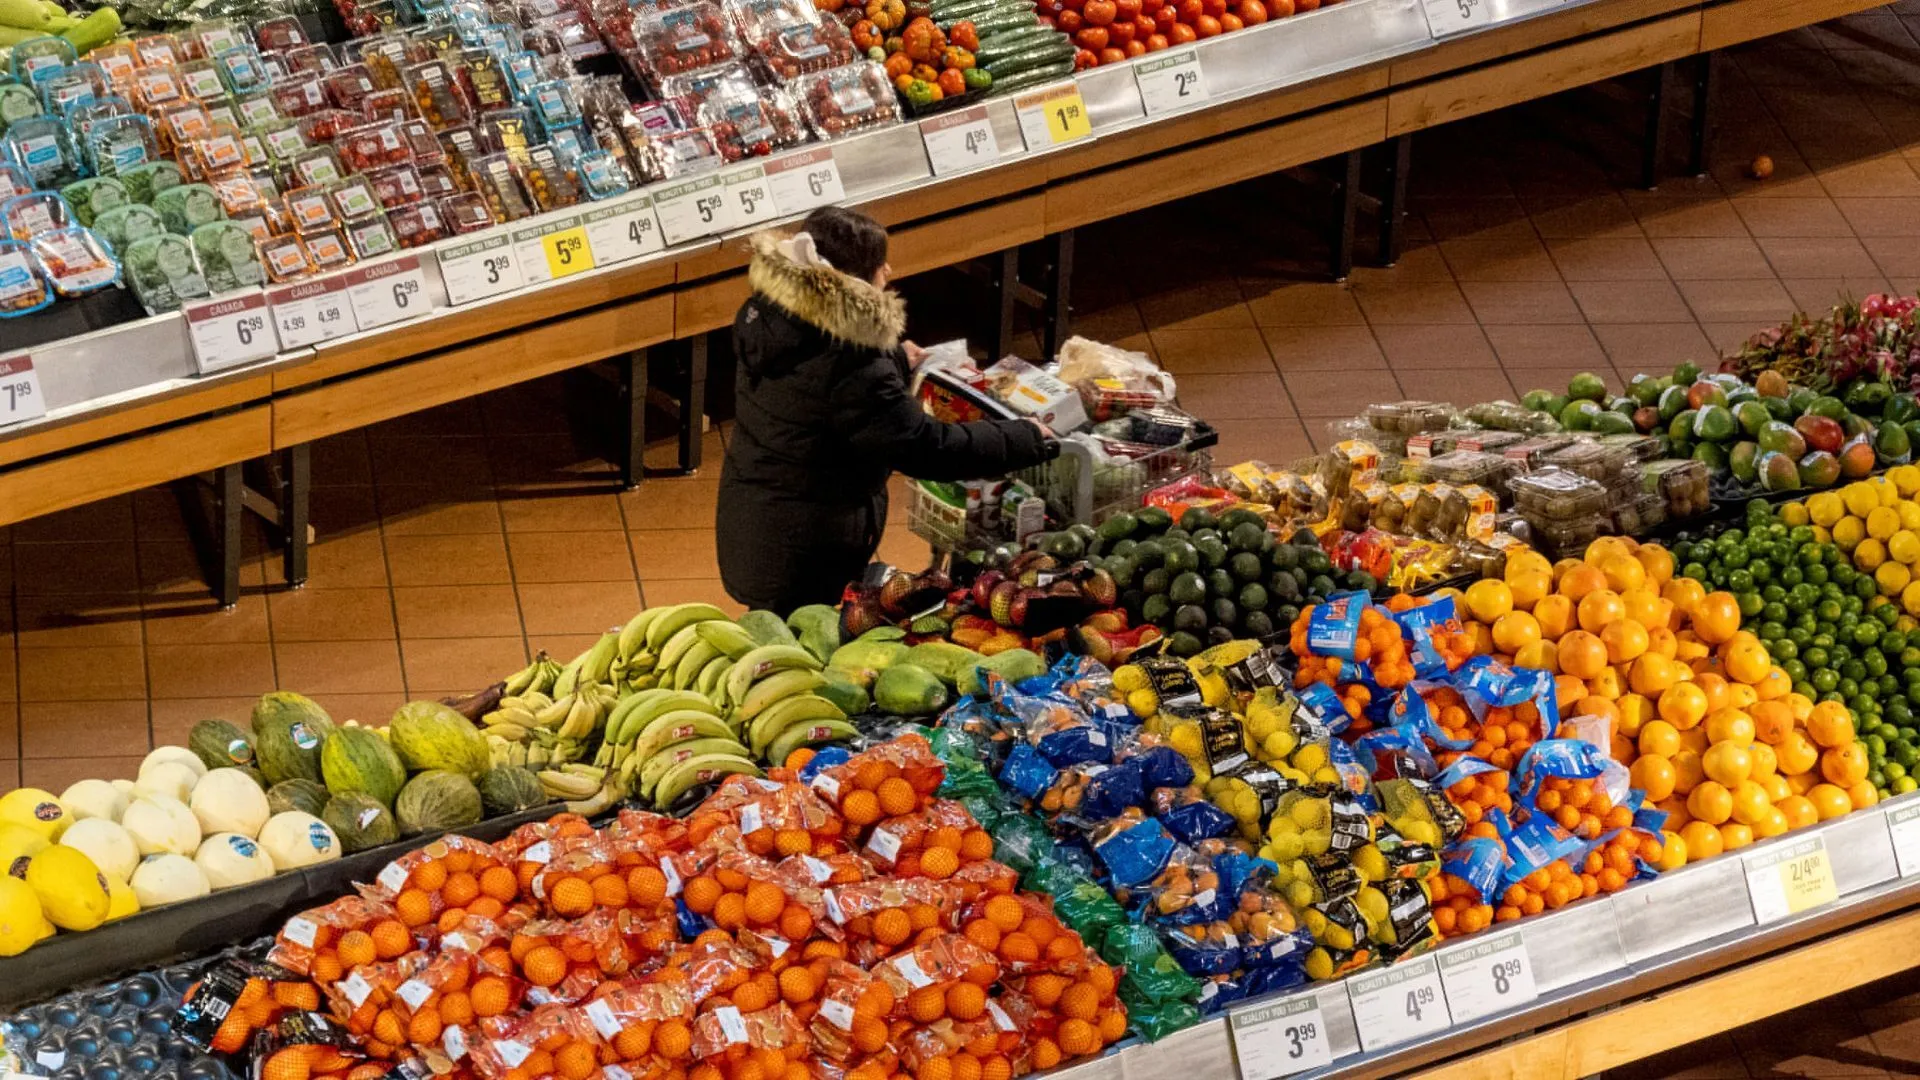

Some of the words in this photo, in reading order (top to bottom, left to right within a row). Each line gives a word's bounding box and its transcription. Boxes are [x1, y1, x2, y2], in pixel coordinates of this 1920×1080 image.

[365, 262, 399, 279] CANADA
[290, 282, 326, 299] CANADA
[209, 300, 245, 317] CANADA
[283, 317, 305, 332] 4.99
[318, 307, 340, 323] 4.99
[1446, 946, 1477, 965] QUALITY
[1477, 942, 1492, 956] YOU
[1492, 934, 1515, 951] TRUST
[1357, 974, 1388, 992] QUALITY
[1388, 968, 1403, 982] YOU
[1404, 962, 1427, 979] TRUST
[1241, 1010, 1270, 1025] QUALITY
[1271, 1005, 1287, 1017] YOU
[1287, 999, 1311, 1013] TRUST
